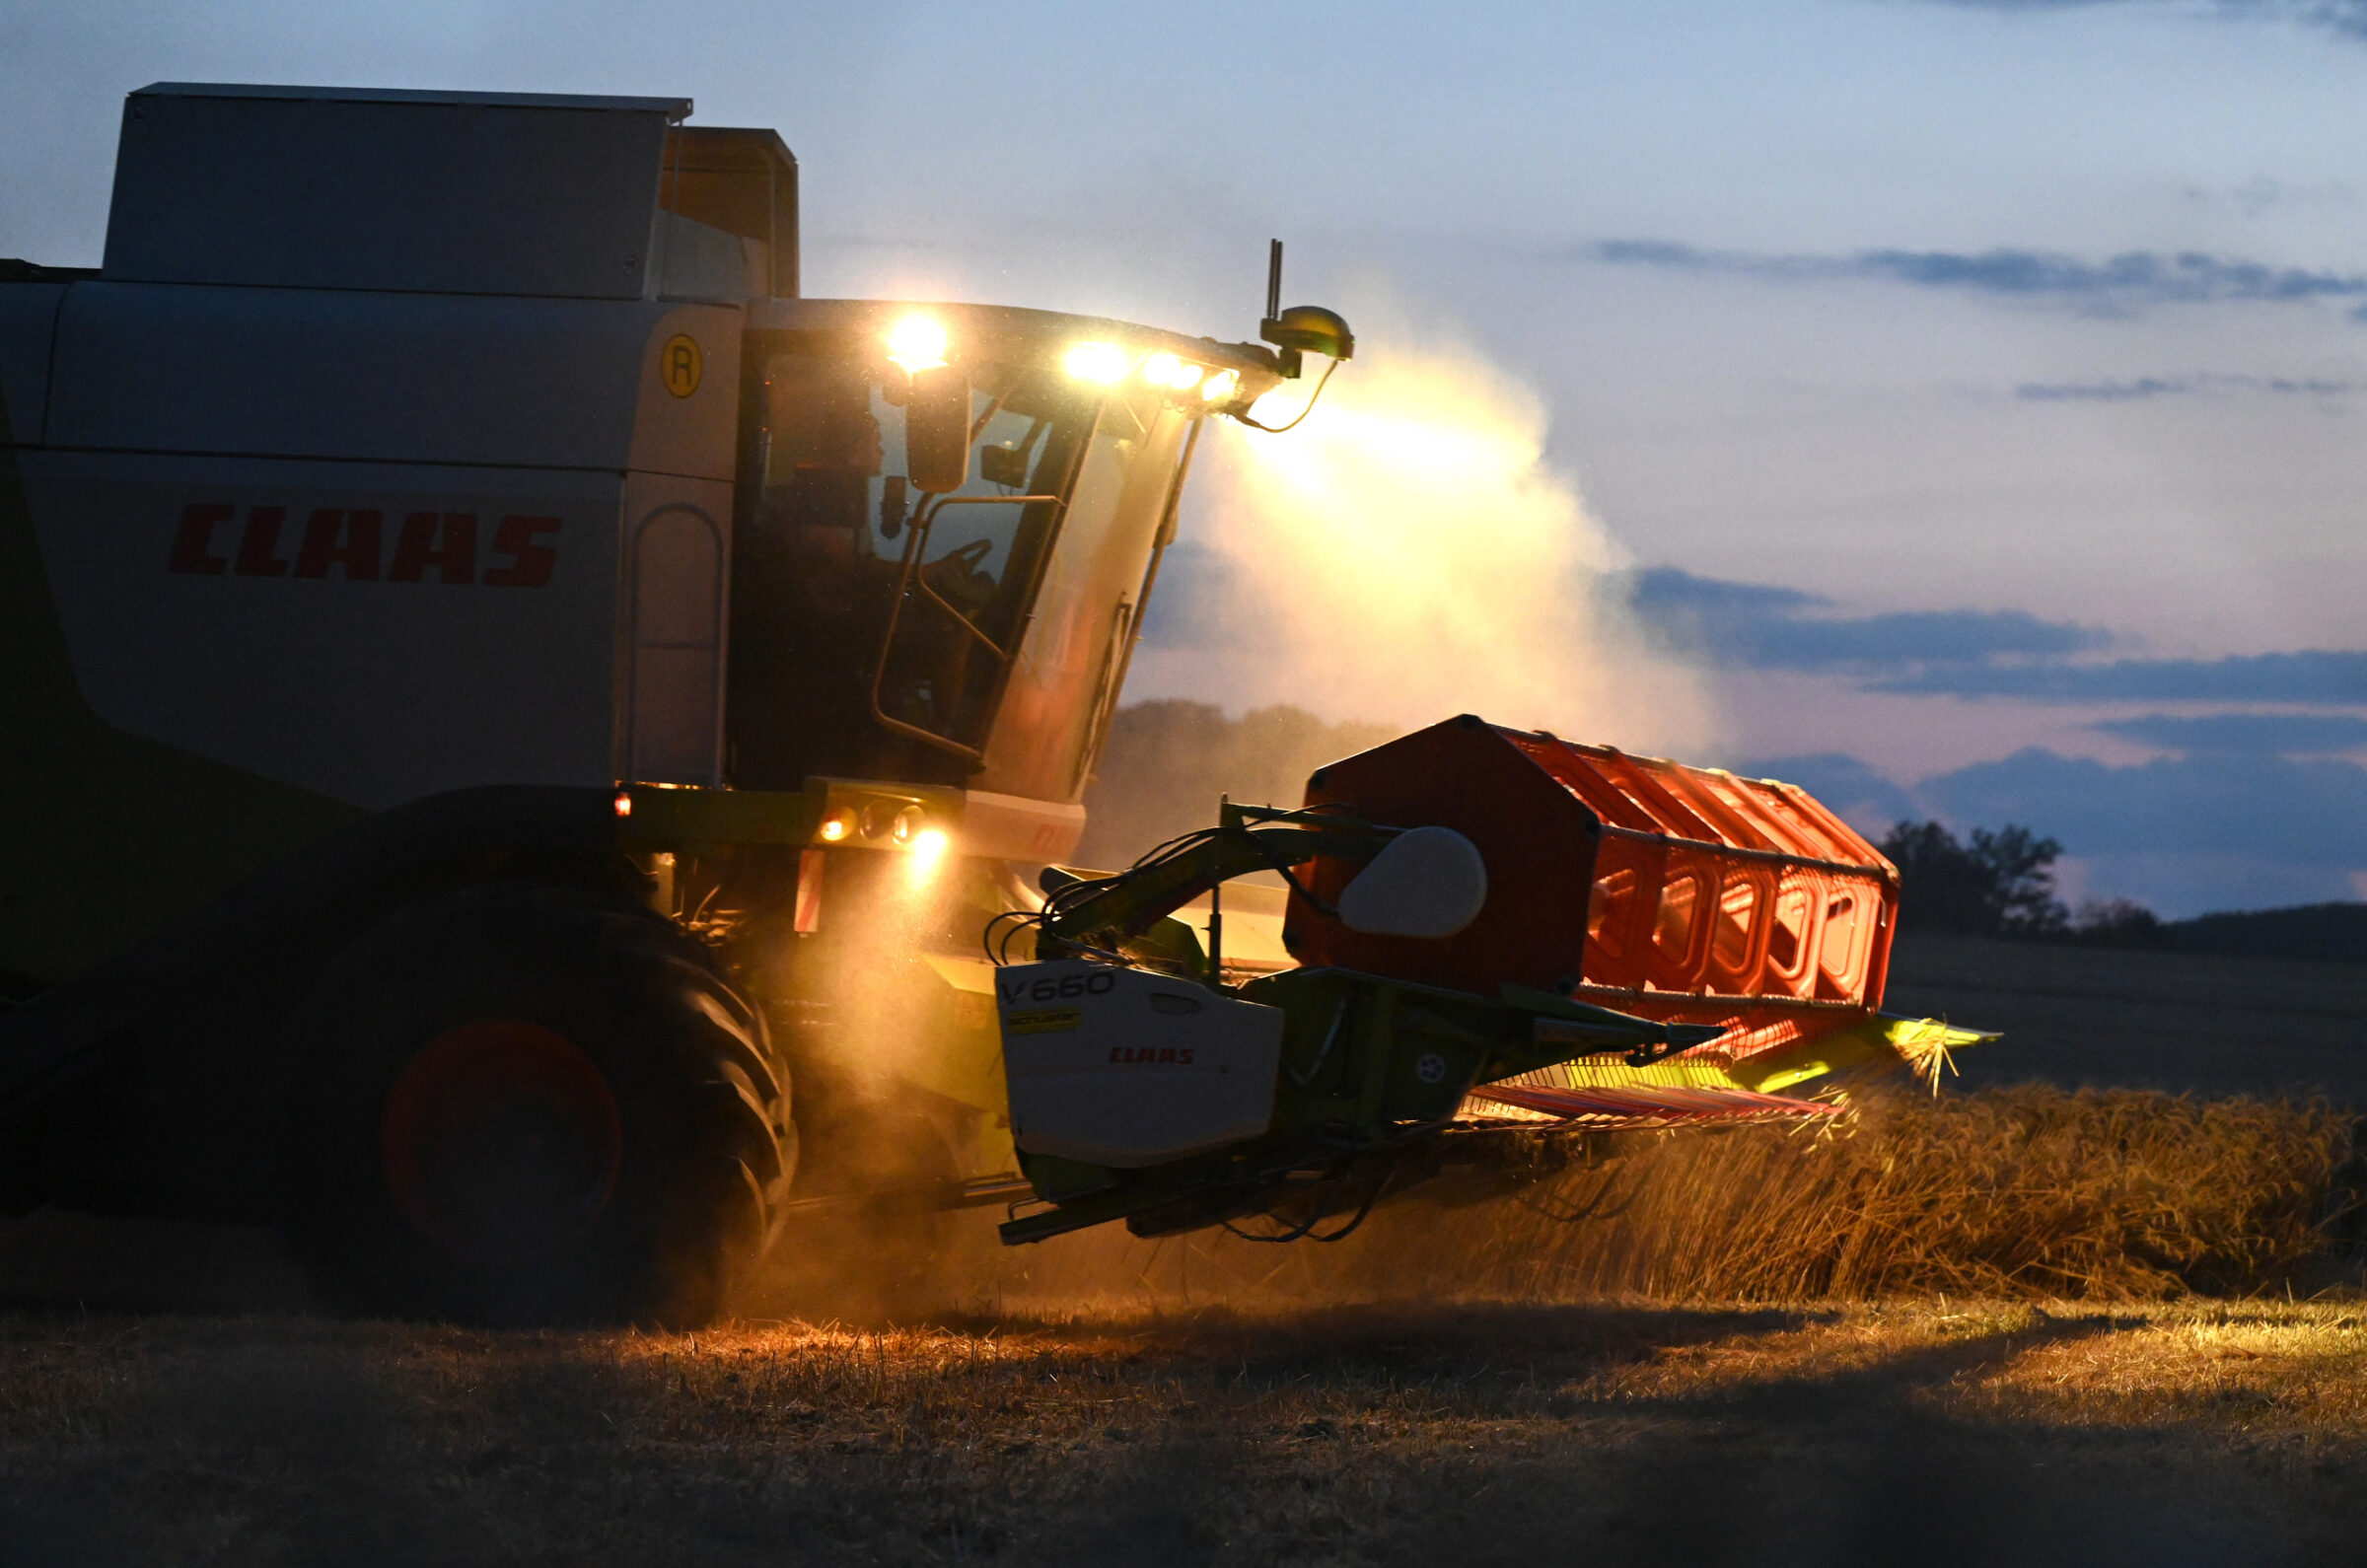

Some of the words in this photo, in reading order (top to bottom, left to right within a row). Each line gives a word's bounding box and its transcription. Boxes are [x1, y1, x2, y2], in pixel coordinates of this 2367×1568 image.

[672, 345, 692, 386] R
[168, 503, 564, 587] CLAAS
[1110, 1046, 1193, 1065] CLAAS
